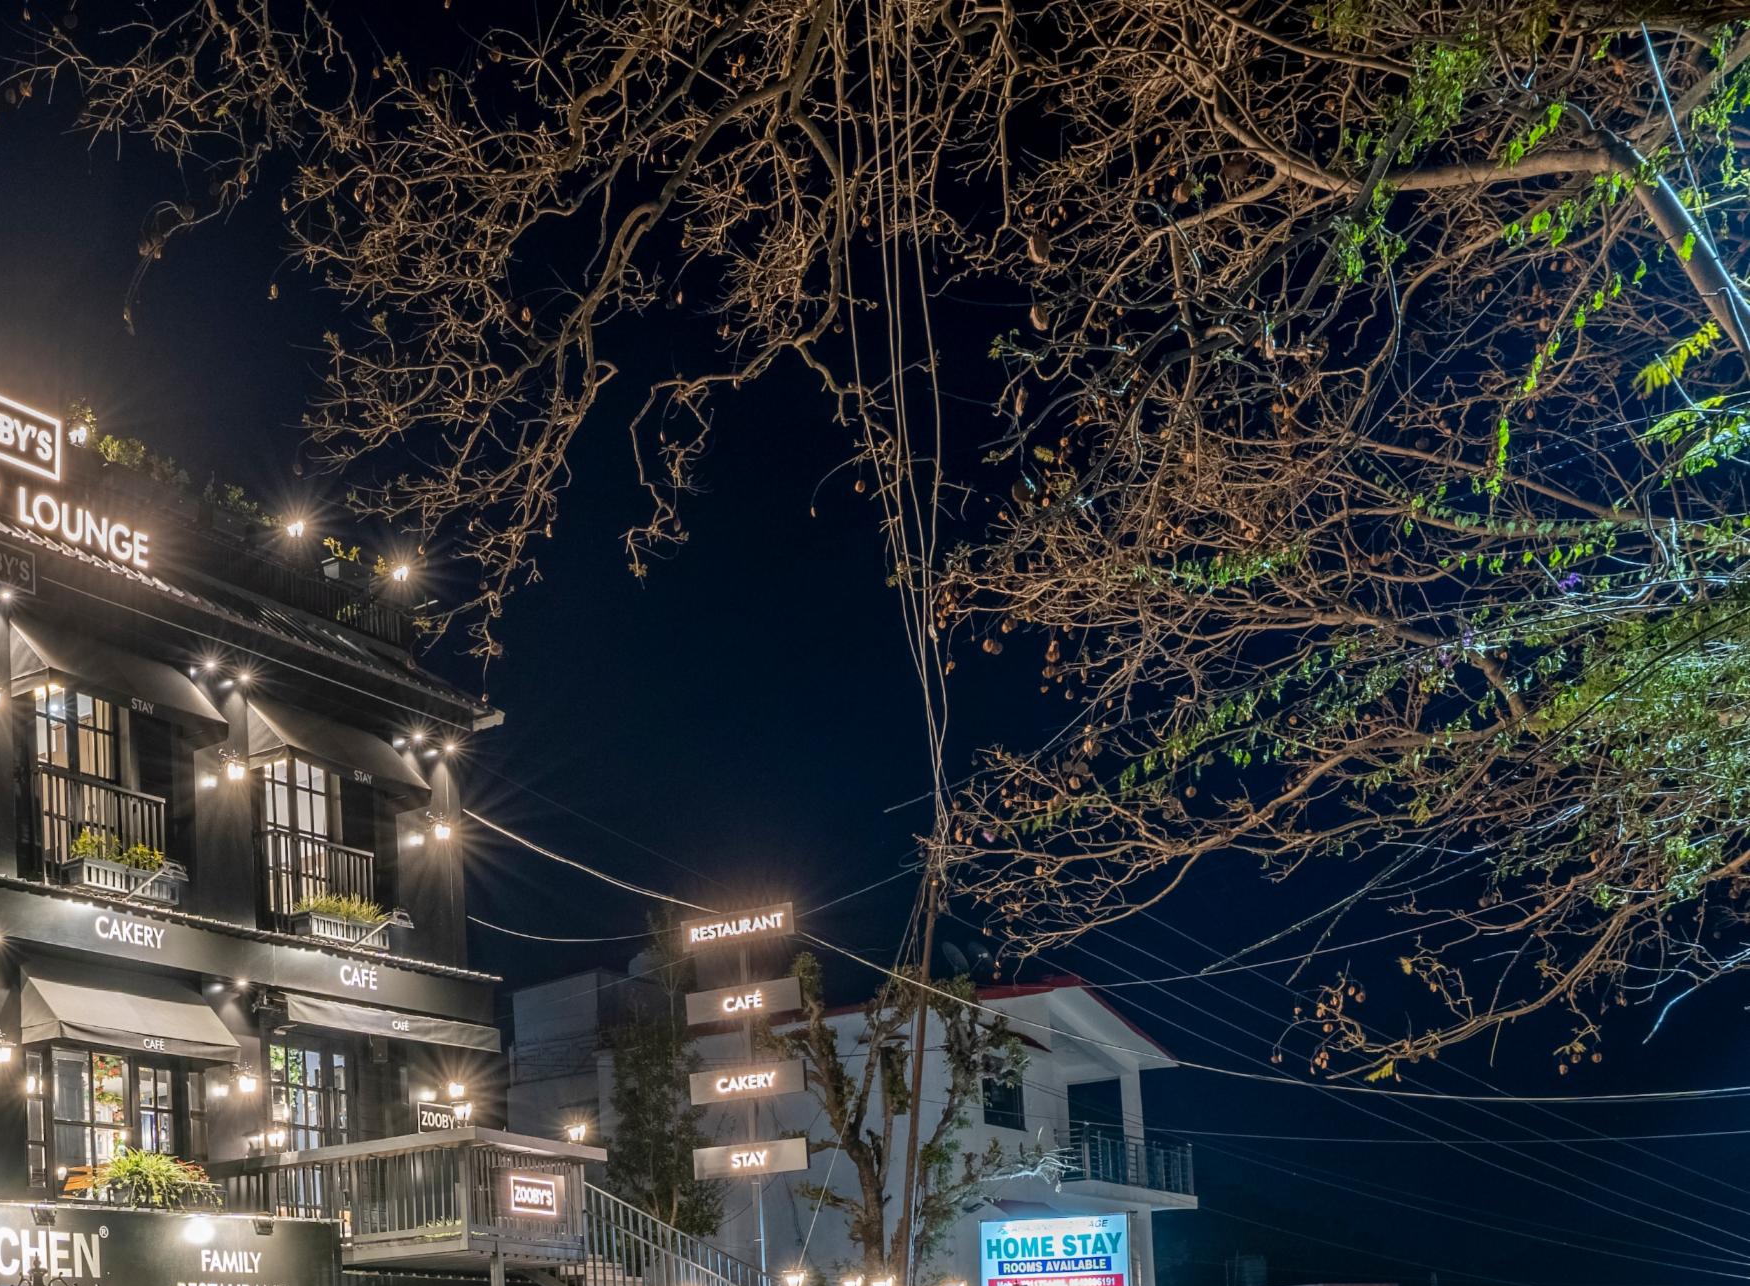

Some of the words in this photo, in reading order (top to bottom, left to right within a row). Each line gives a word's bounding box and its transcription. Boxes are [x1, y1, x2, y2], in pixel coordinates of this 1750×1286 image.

[18, 486, 149, 569] LOUNGE
[131, 697, 154, 716] STAY
[354, 770, 373, 784] STAY
[95, 915, 165, 949] CAKERY
[691, 912, 784, 943] RESTAURANT
[340, 962, 378, 991] CAFÉ
[723, 990, 763, 1012] CAFÉ
[392, 1018, 410, 1031] CAFÉ
[143, 1037, 165, 1051] CAFÉ
[716, 1071, 775, 1094] CAKERY
[731, 1150, 768, 1168] STAY
[514, 1185, 553, 1207] ZOOBY'S
[986, 1235, 1055, 1260] HOME
[1062, 1231, 1122, 1257] STAY
[200, 1249, 262, 1274] FAMILY
[1003, 1261, 1043, 1273] ROOMS
[1045, 1258, 1107, 1273] AVAILABLE
